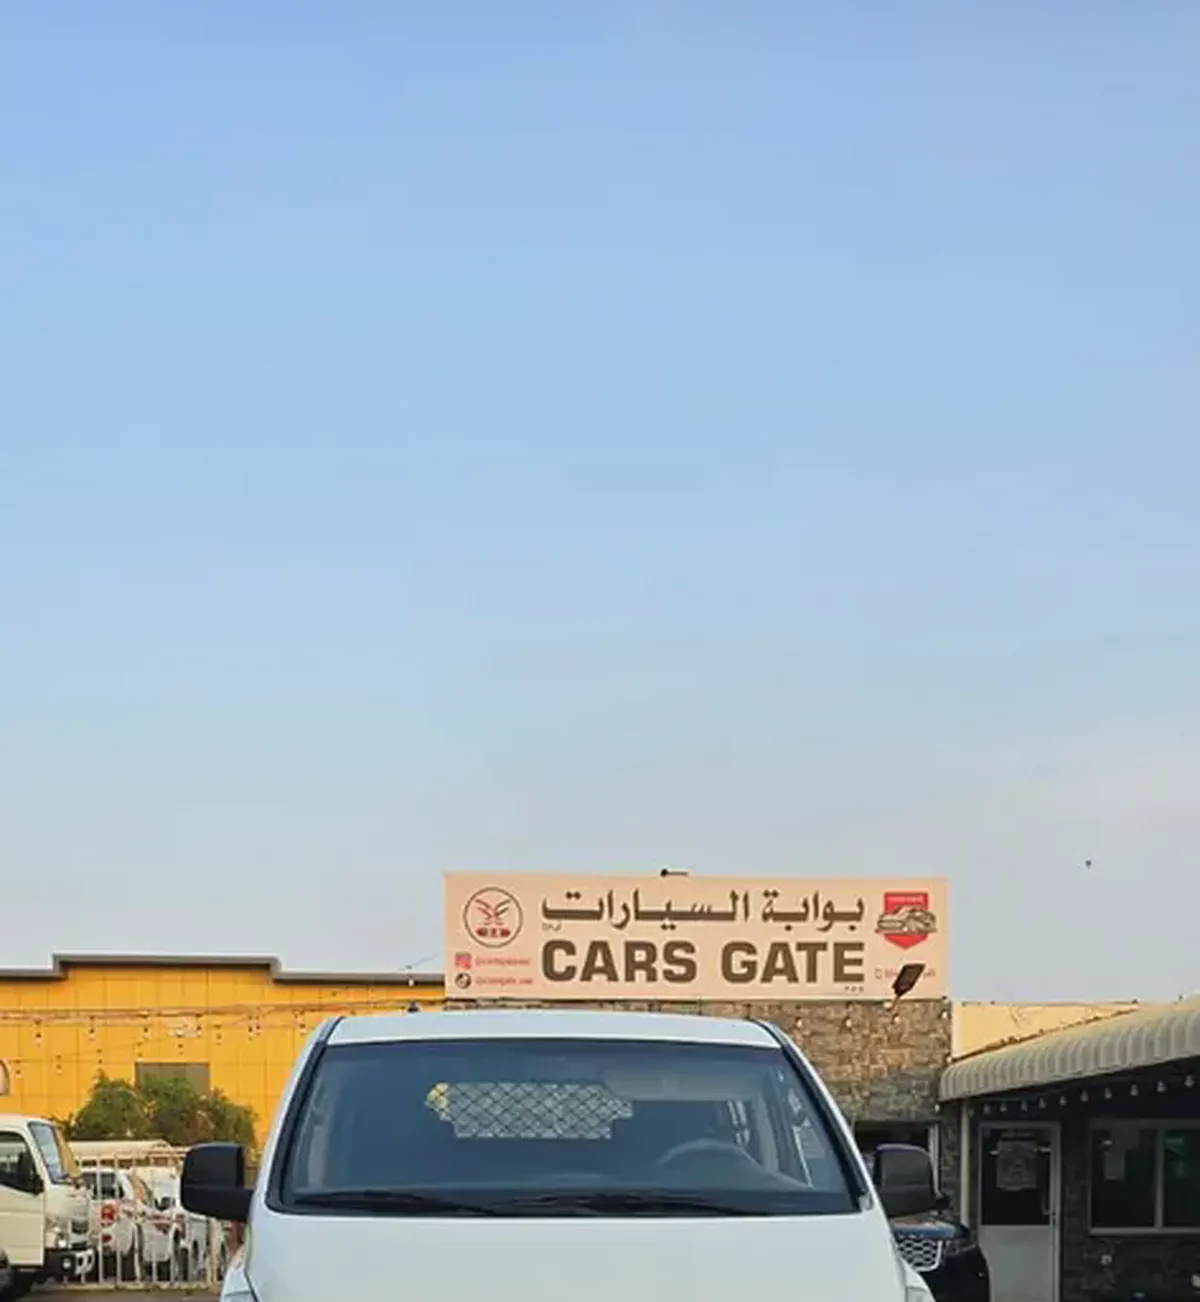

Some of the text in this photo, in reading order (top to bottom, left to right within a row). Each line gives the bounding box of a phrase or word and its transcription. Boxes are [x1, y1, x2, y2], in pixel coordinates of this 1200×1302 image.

[541, 888, 865, 932] بوابة السيارات
[541, 939, 865, 984] CARS GATE
